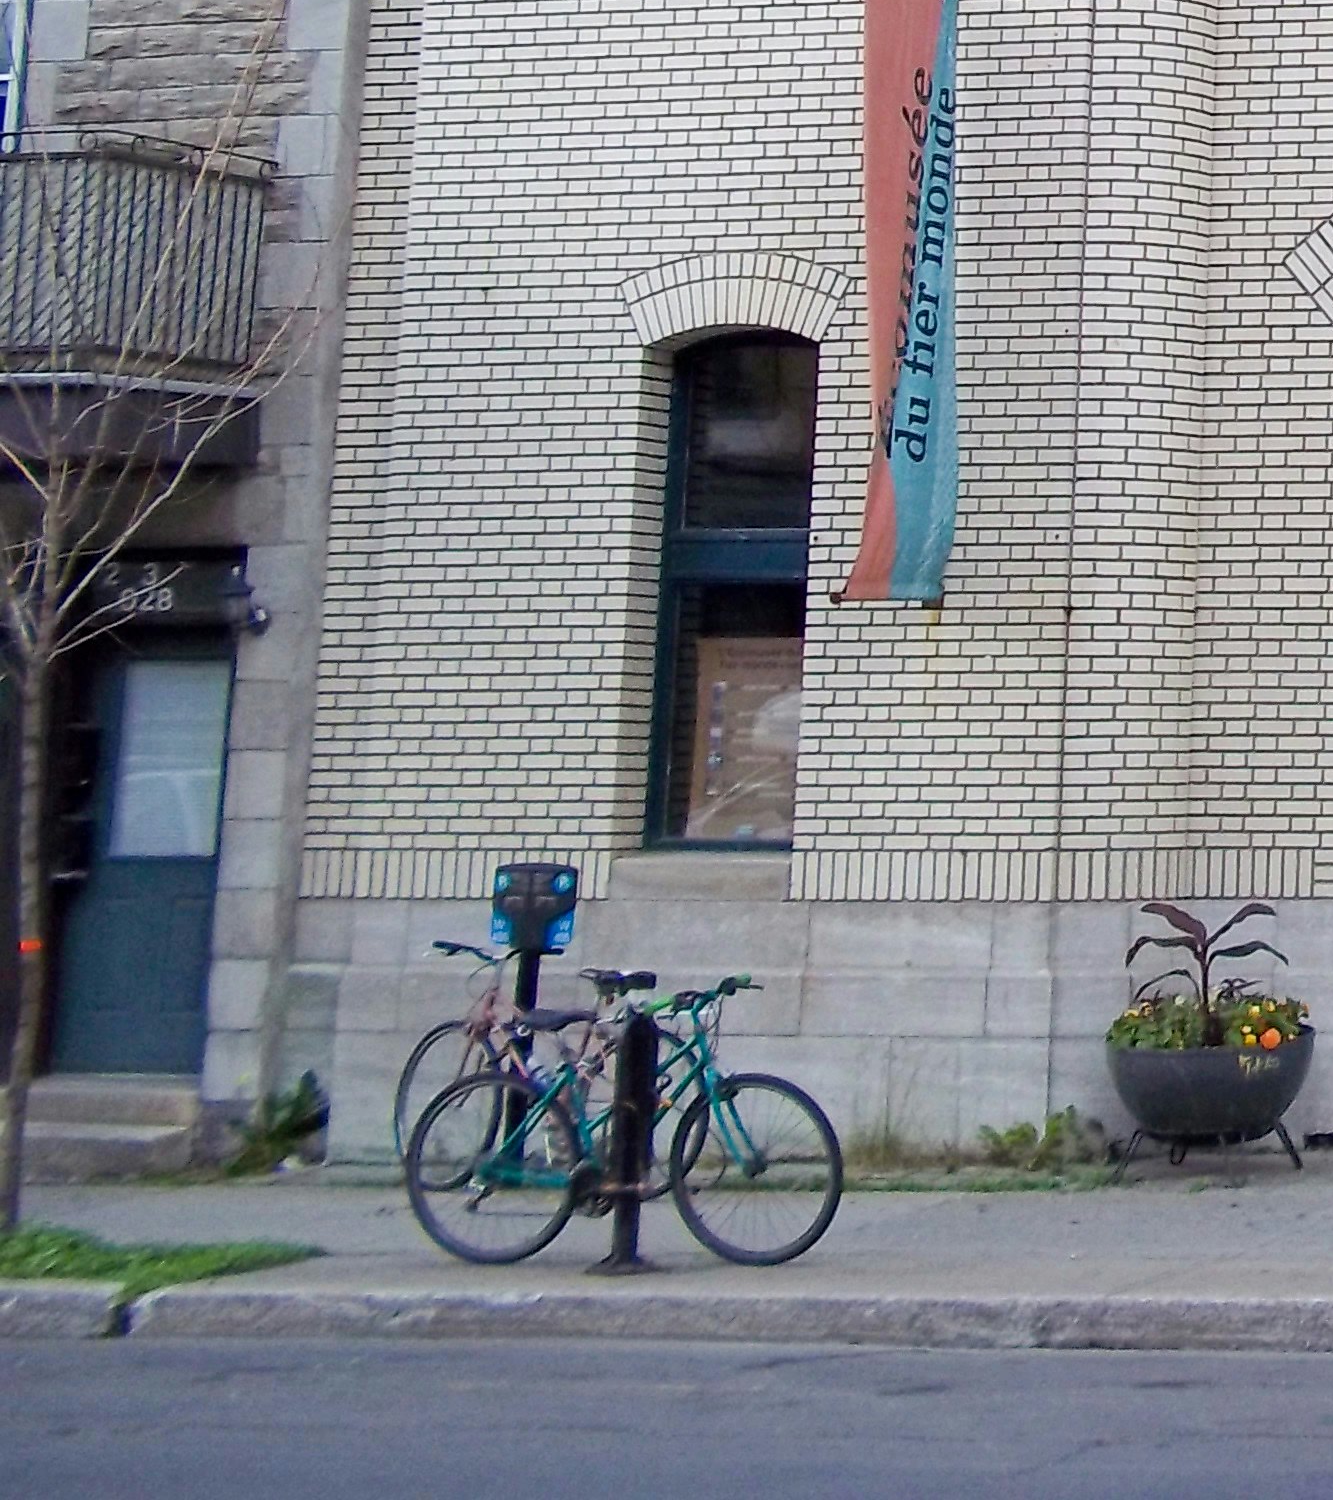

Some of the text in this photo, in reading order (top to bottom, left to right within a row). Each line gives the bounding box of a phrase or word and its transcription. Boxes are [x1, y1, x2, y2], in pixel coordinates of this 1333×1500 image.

[895, 87, 957, 462] du fier monde
